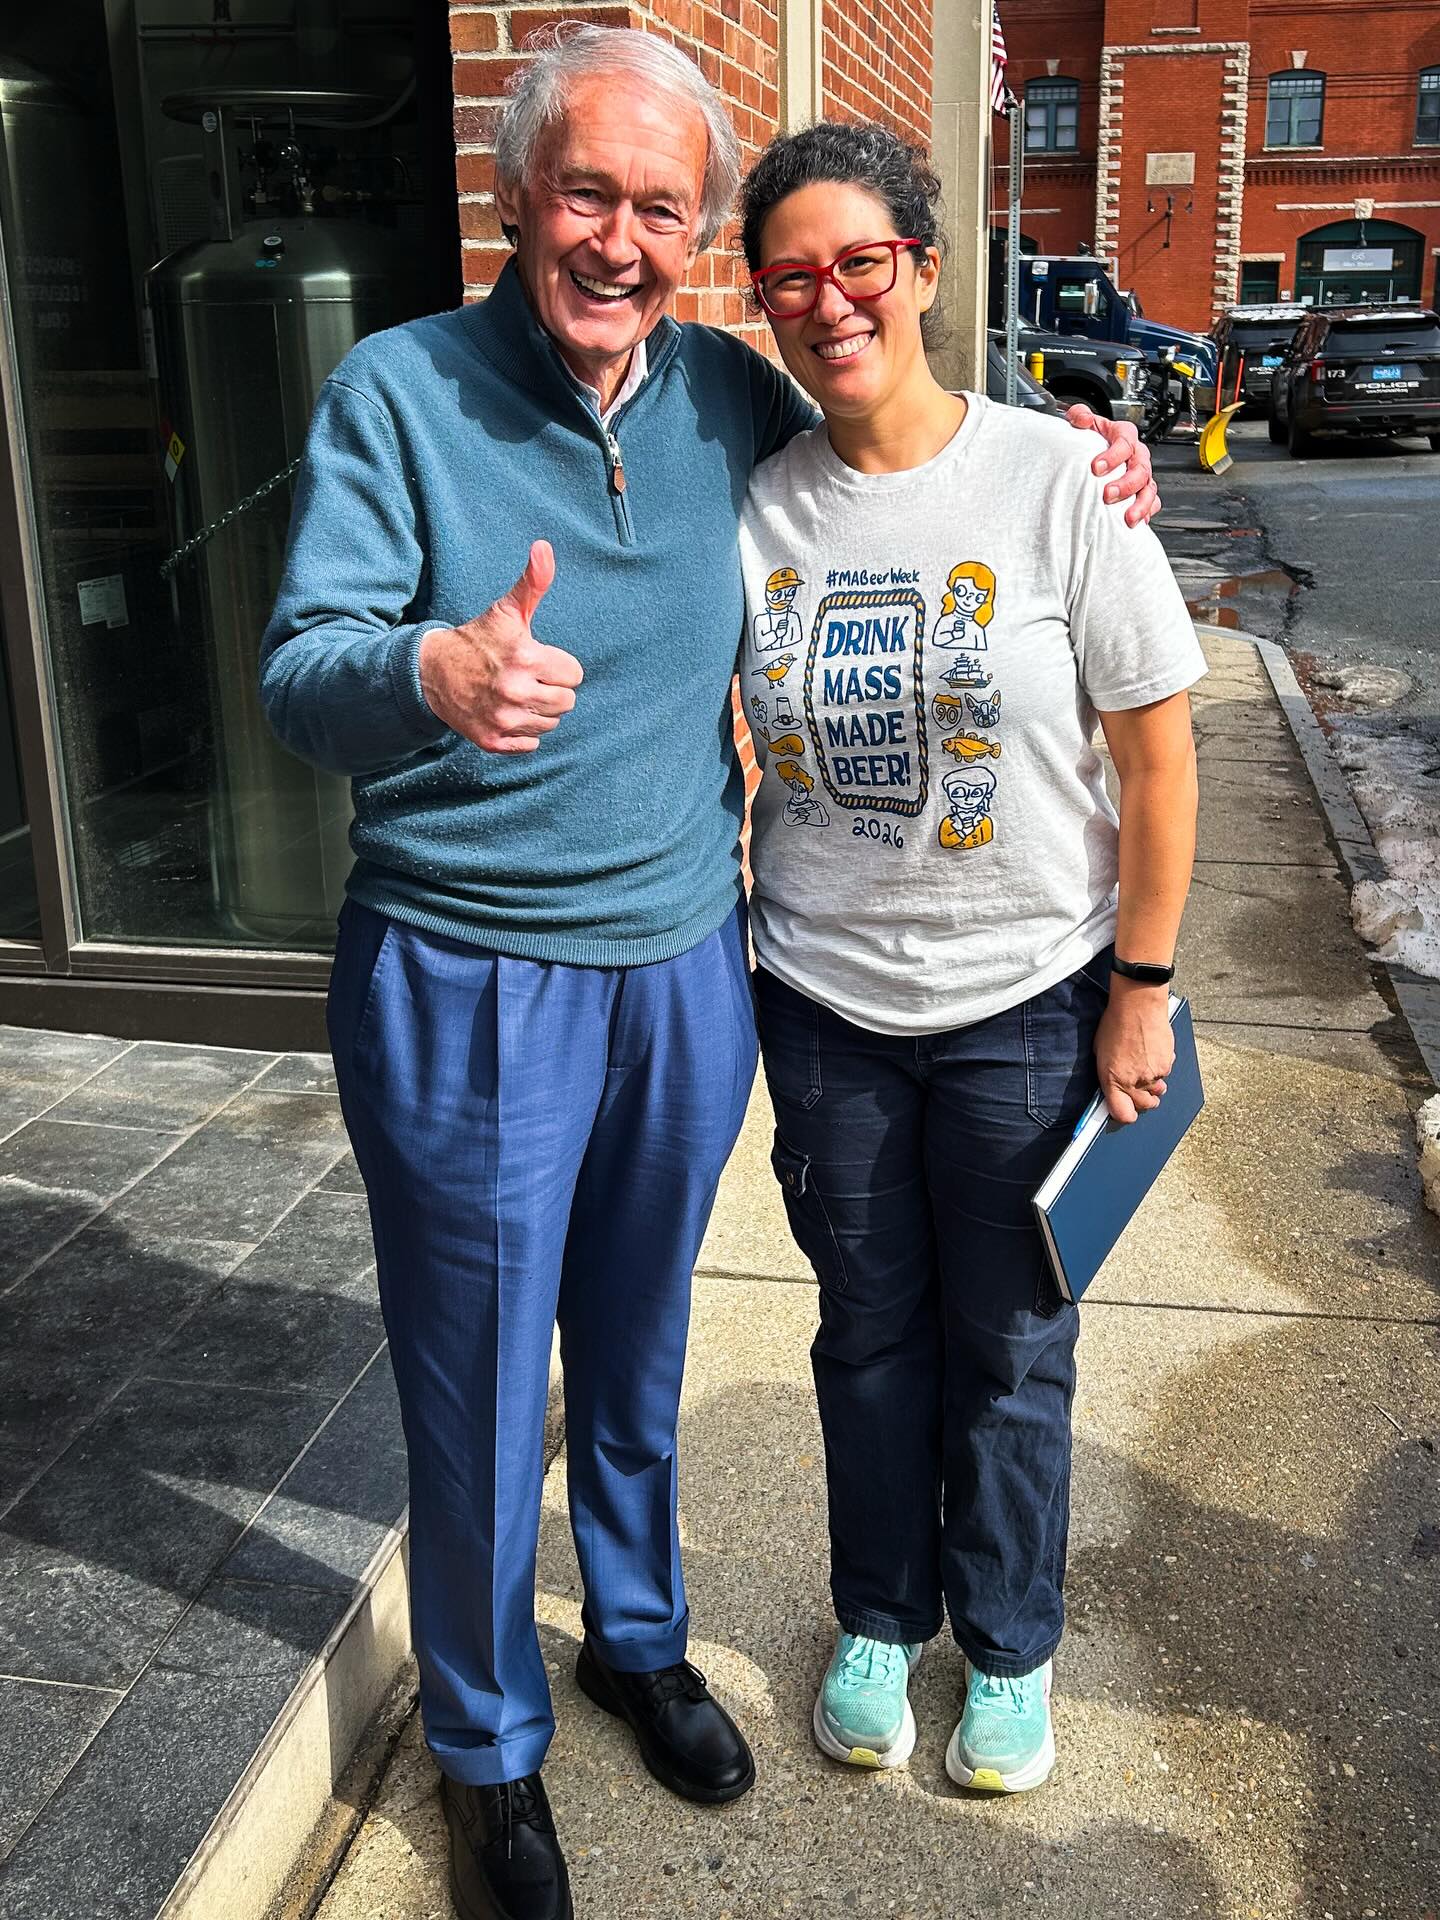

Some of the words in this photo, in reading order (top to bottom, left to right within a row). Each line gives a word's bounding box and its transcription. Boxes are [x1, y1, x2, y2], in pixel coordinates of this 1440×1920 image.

[1327, 369, 1346, 378] 173
[1354, 381, 1419, 389] POLICE
[822, 616, 909, 658] DRINK
[824, 665, 902, 706] MASS
[825, 711, 907, 748] MADE
[936, 704, 959, 724] 90
[833, 753, 910, 787] BEER!
[853, 816, 904, 849] 2026
